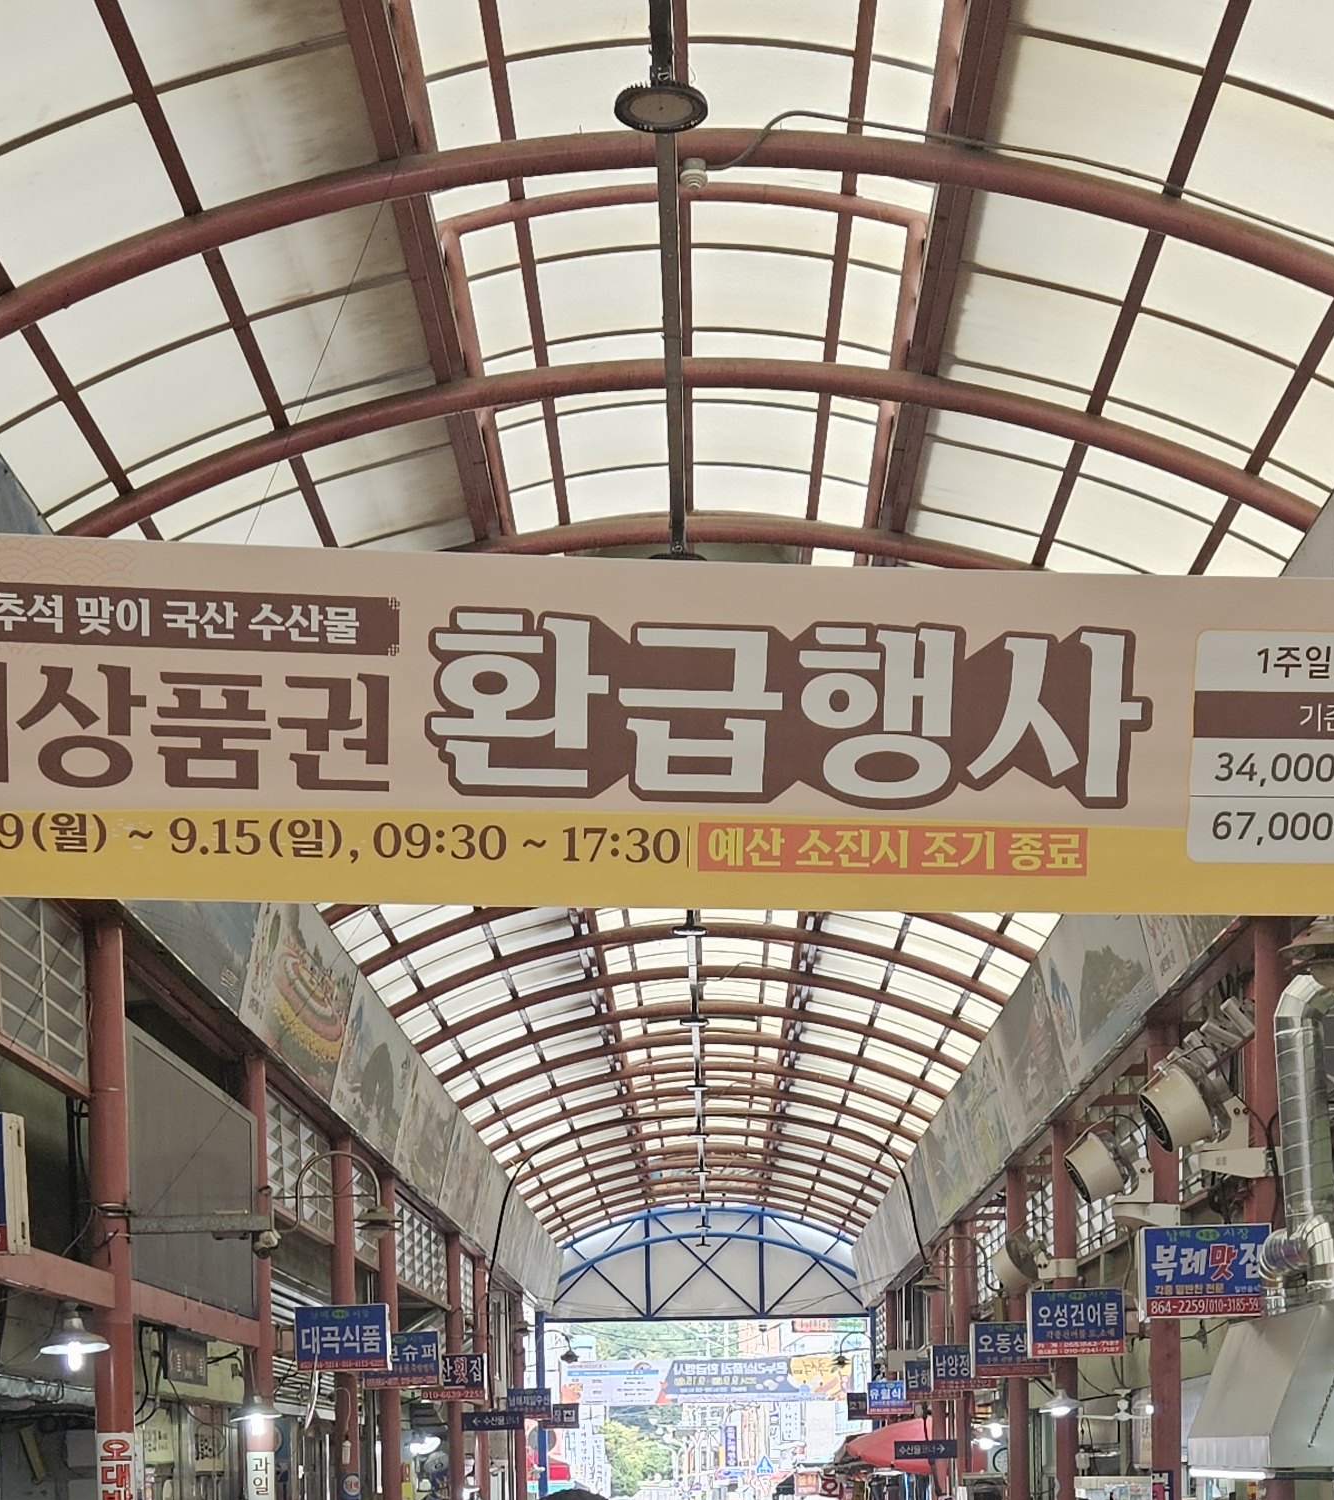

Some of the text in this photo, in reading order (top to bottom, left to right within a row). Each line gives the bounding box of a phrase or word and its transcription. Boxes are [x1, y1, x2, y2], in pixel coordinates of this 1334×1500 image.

[76, 596, 152, 637] 맞이
[163, 600, 237, 641] 국산
[248, 604, 361, 646] 수산물
[427, 608, 1149, 806] 환급행사
[168, 816, 361, 864] 9.15(일),
[373, 822, 508, 862] 09:30
[561, 826, 682, 864] 17:30
[707, 828, 783, 869] 예산
[797, 829, 910, 871] 소진시
[921, 831, 998, 872] 조기
[1007, 833, 1084, 872] 종료
[1234, 1284, 1262, 1294] 일반음식
[1037, 1302, 1119, 1328] 오성건어물
[300, 1324, 383, 1355] 대곡식품
[253, 1457, 270, 1496] 과일
